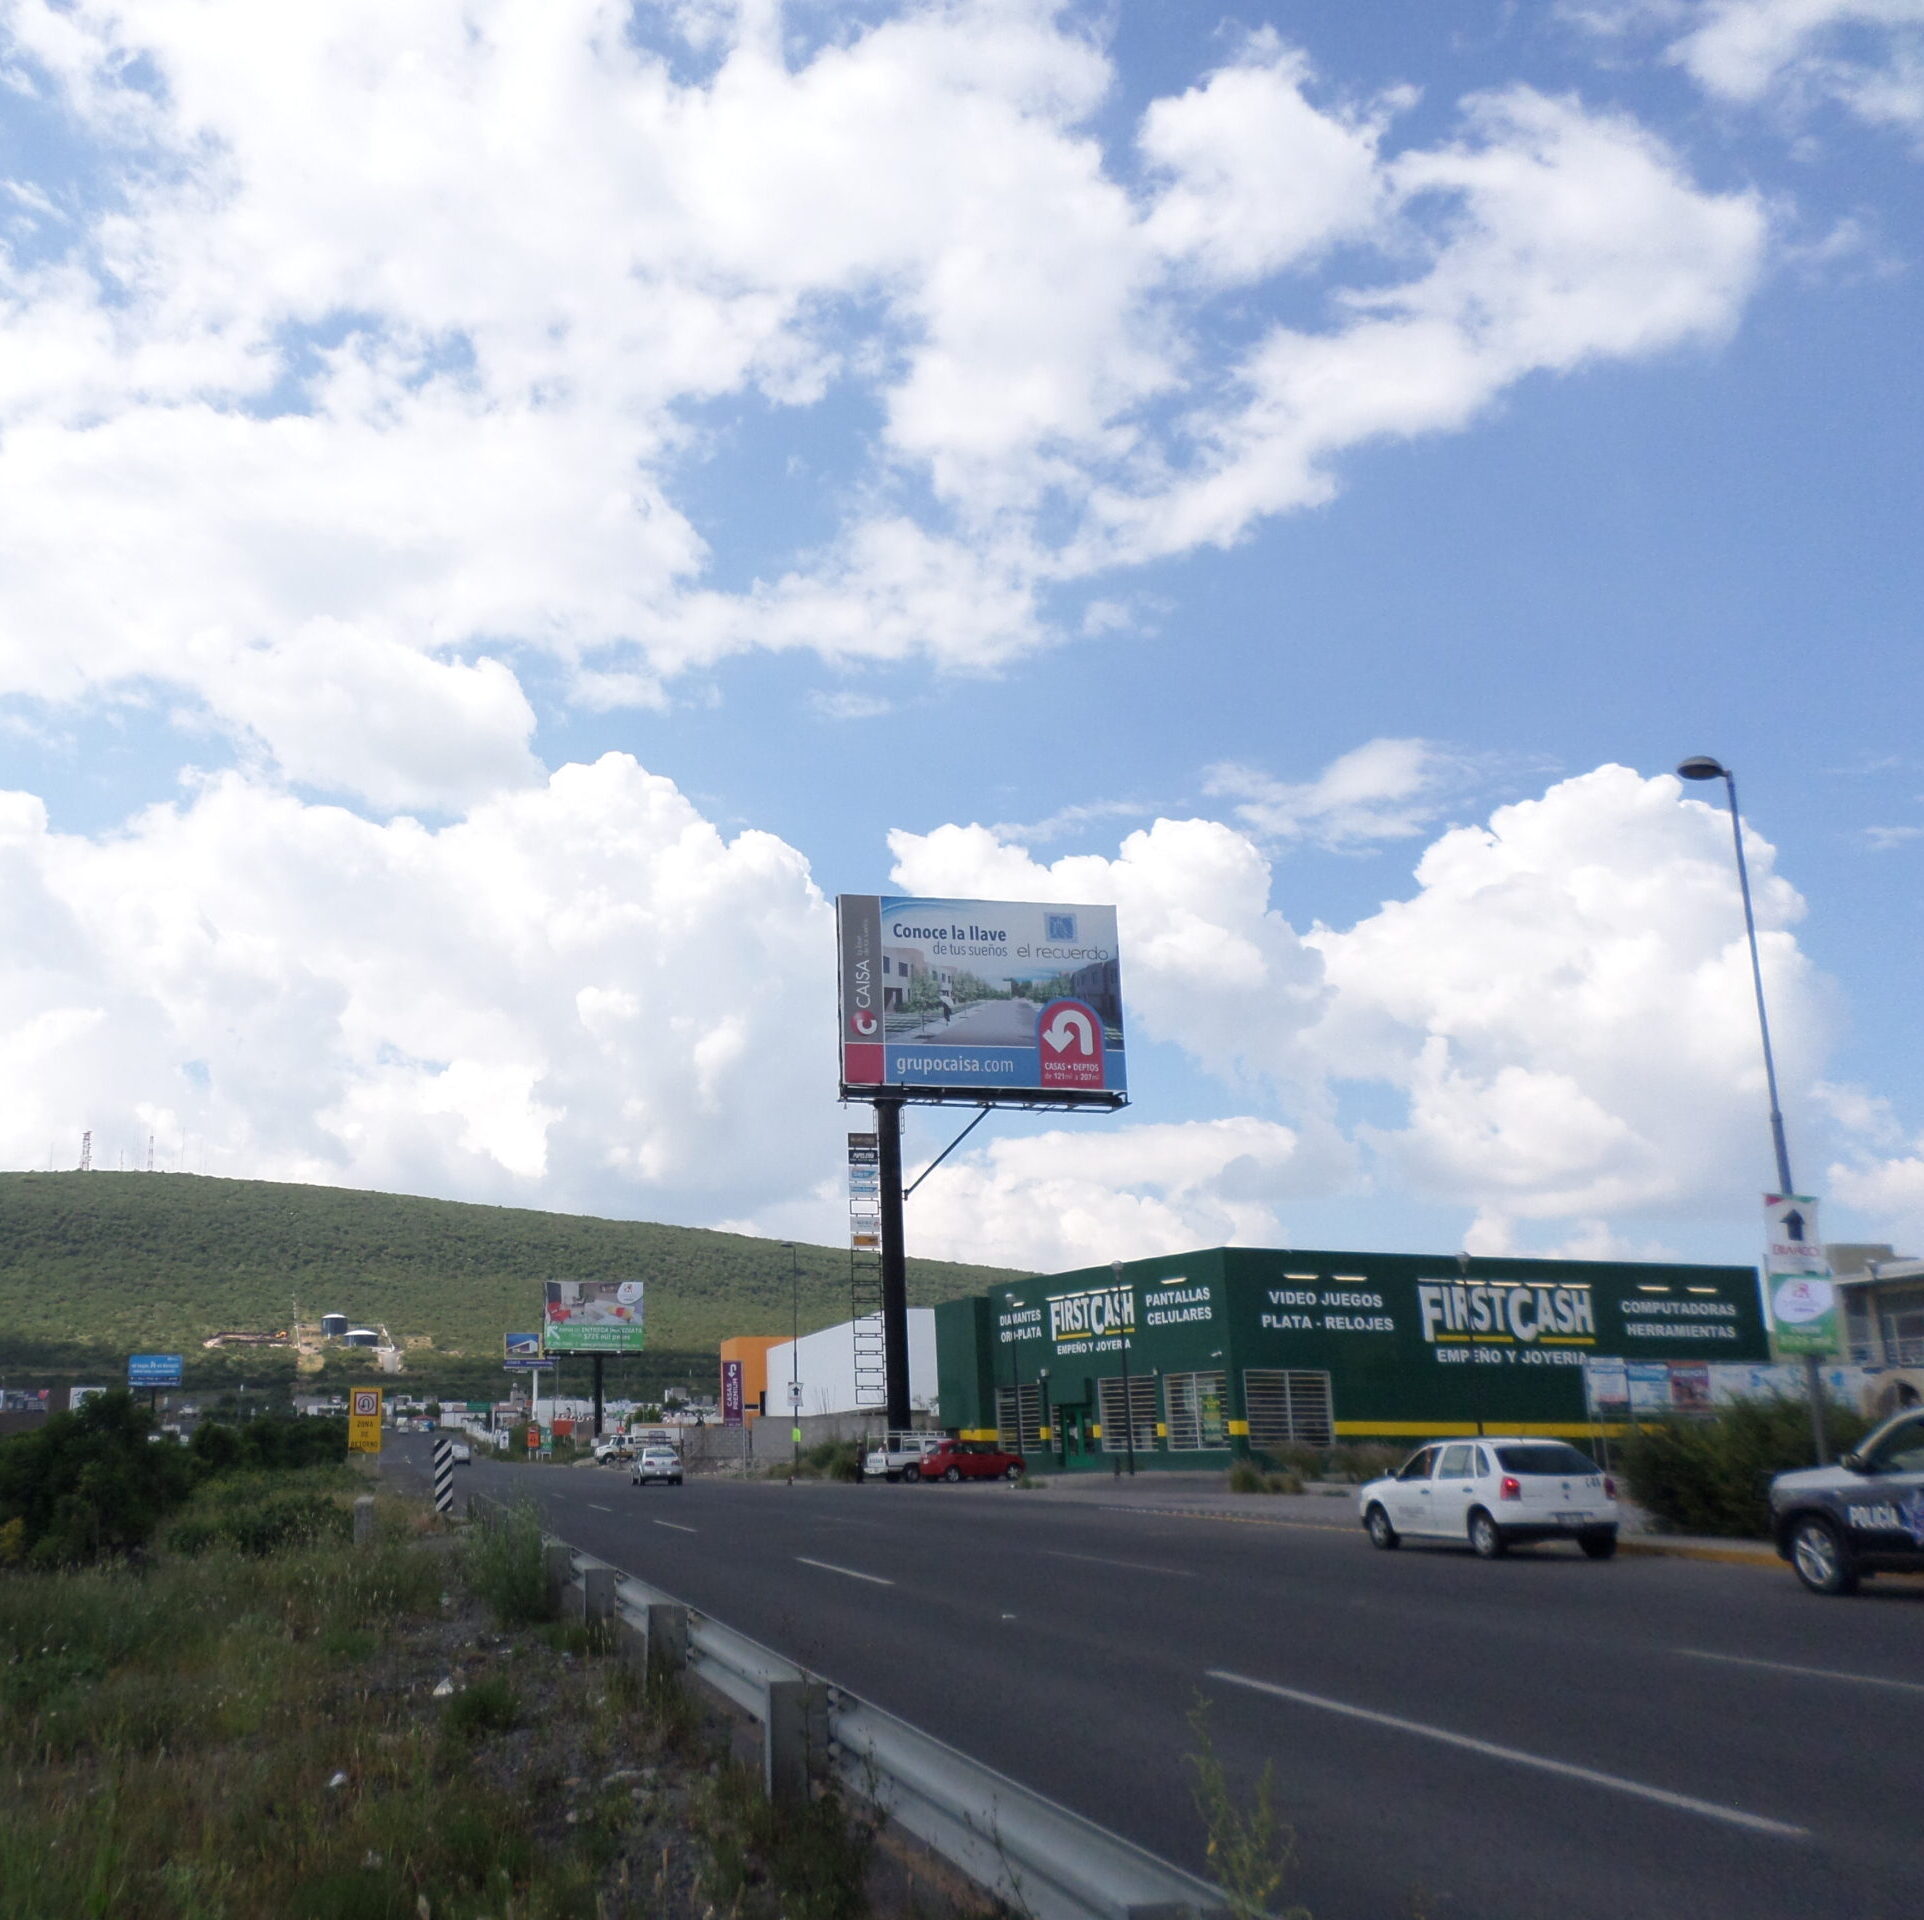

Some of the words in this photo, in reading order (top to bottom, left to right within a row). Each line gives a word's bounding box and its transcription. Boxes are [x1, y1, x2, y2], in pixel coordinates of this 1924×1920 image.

[893, 923, 947, 940] Conoce
[952, 925, 966, 940] la
[970, 926, 1006, 942] llave
[933, 942, 948, 955] de
[950, 944, 966, 956] tus
[969, 943, 1008, 957] sueños
[1017, 944, 1031, 958] el
[1036, 945, 1109, 960] recuerdo
[856, 960, 870, 1009] CAISA
[897, 1056, 1014, 1074] grupocaisa.com
[1044, 1062, 1066, 1071] CASAS
[1073, 1063, 1099, 1072] DEPTOS
[1146, 1287, 1210, 1306] PANTALLAS
[1268, 1291, 1316, 1306] VIDEO
[1321, 1293, 1384, 1309] JUEGOS
[1050, 1292, 1136, 1341] FIRSTCASH
[1147, 1307, 1212, 1325] CELULARES
[1417, 1283, 1595, 1342] FIRSTCASH
[1620, 1300, 1736, 1317] COMPUTADORAS
[1262, 1315, 1313, 1330] PLATA
[1325, 1315, 1395, 1332] RELOJES
[1626, 1323, 1736, 1339] HERRAMIENTAS
[1057, 1342, 1087, 1355] EMPEÑO
[1088, 1341, 1094, 1353] Y
[1096, 1338, 1132, 1351] JOYERA
[1437, 1347, 1501, 1363] EMPEÑO
[1506, 1350, 1517, 1363] Y
[1521, 1351, 1587, 1365] JOYERIA
